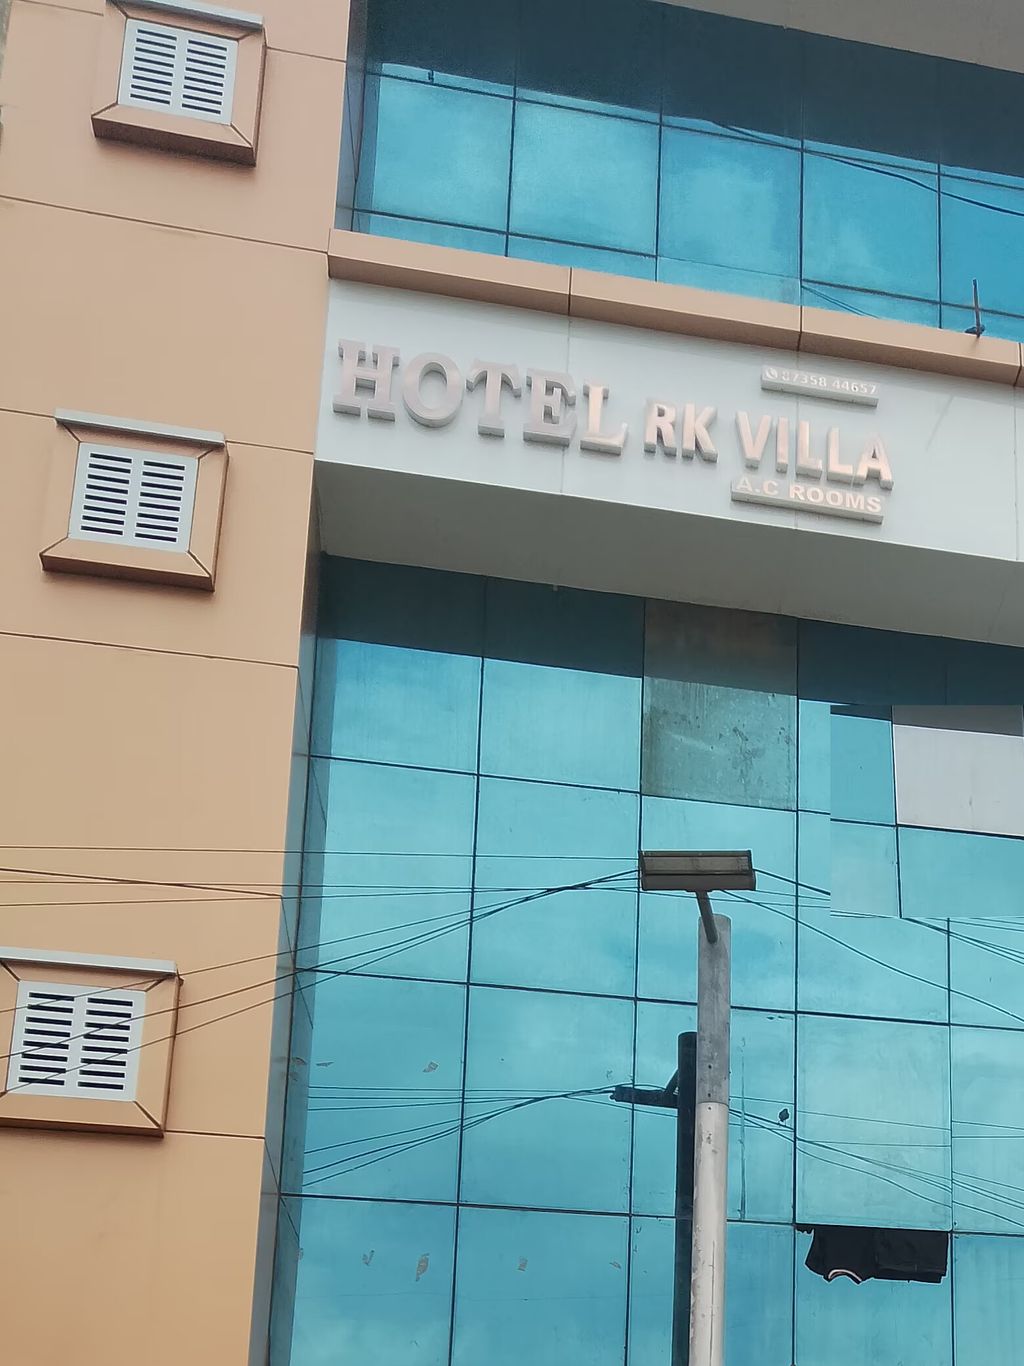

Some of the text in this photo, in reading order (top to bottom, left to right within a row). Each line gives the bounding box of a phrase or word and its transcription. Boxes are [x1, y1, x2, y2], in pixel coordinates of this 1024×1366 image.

[332, 338, 894, 490] HOTEL RK VILLA
[735, 475, 882, 513] A.C ROOMS
